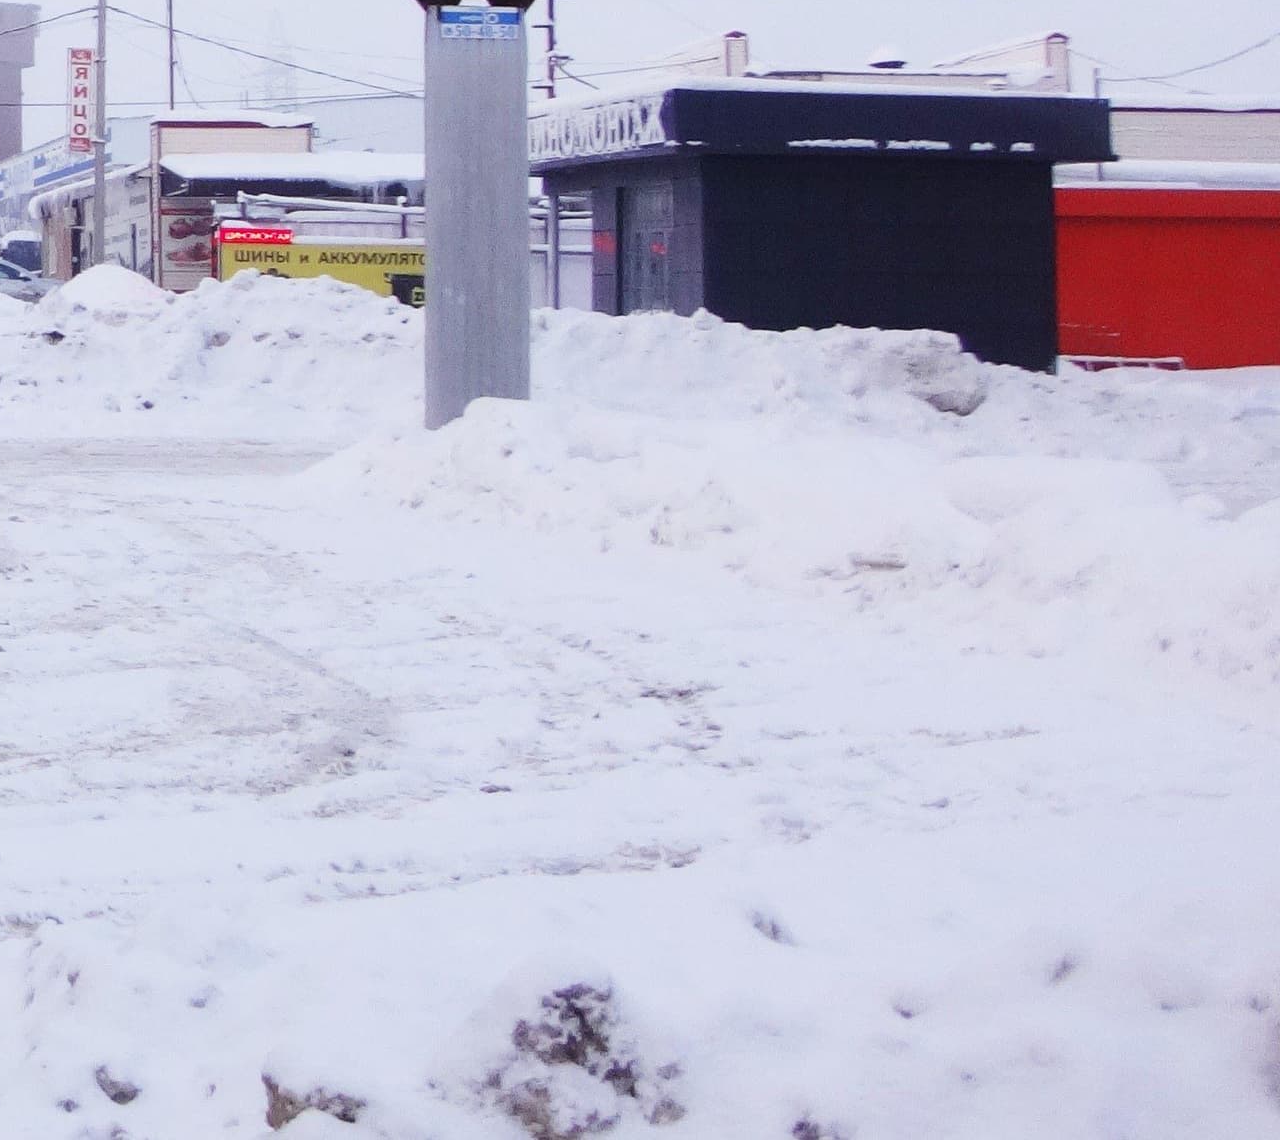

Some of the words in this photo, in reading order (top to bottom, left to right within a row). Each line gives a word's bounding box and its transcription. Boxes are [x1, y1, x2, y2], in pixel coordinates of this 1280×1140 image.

[73, 66, 89, 136] ЯЙЦО
[234, 249, 290, 263] ШИНЫ
[299, 254, 309, 264] и
